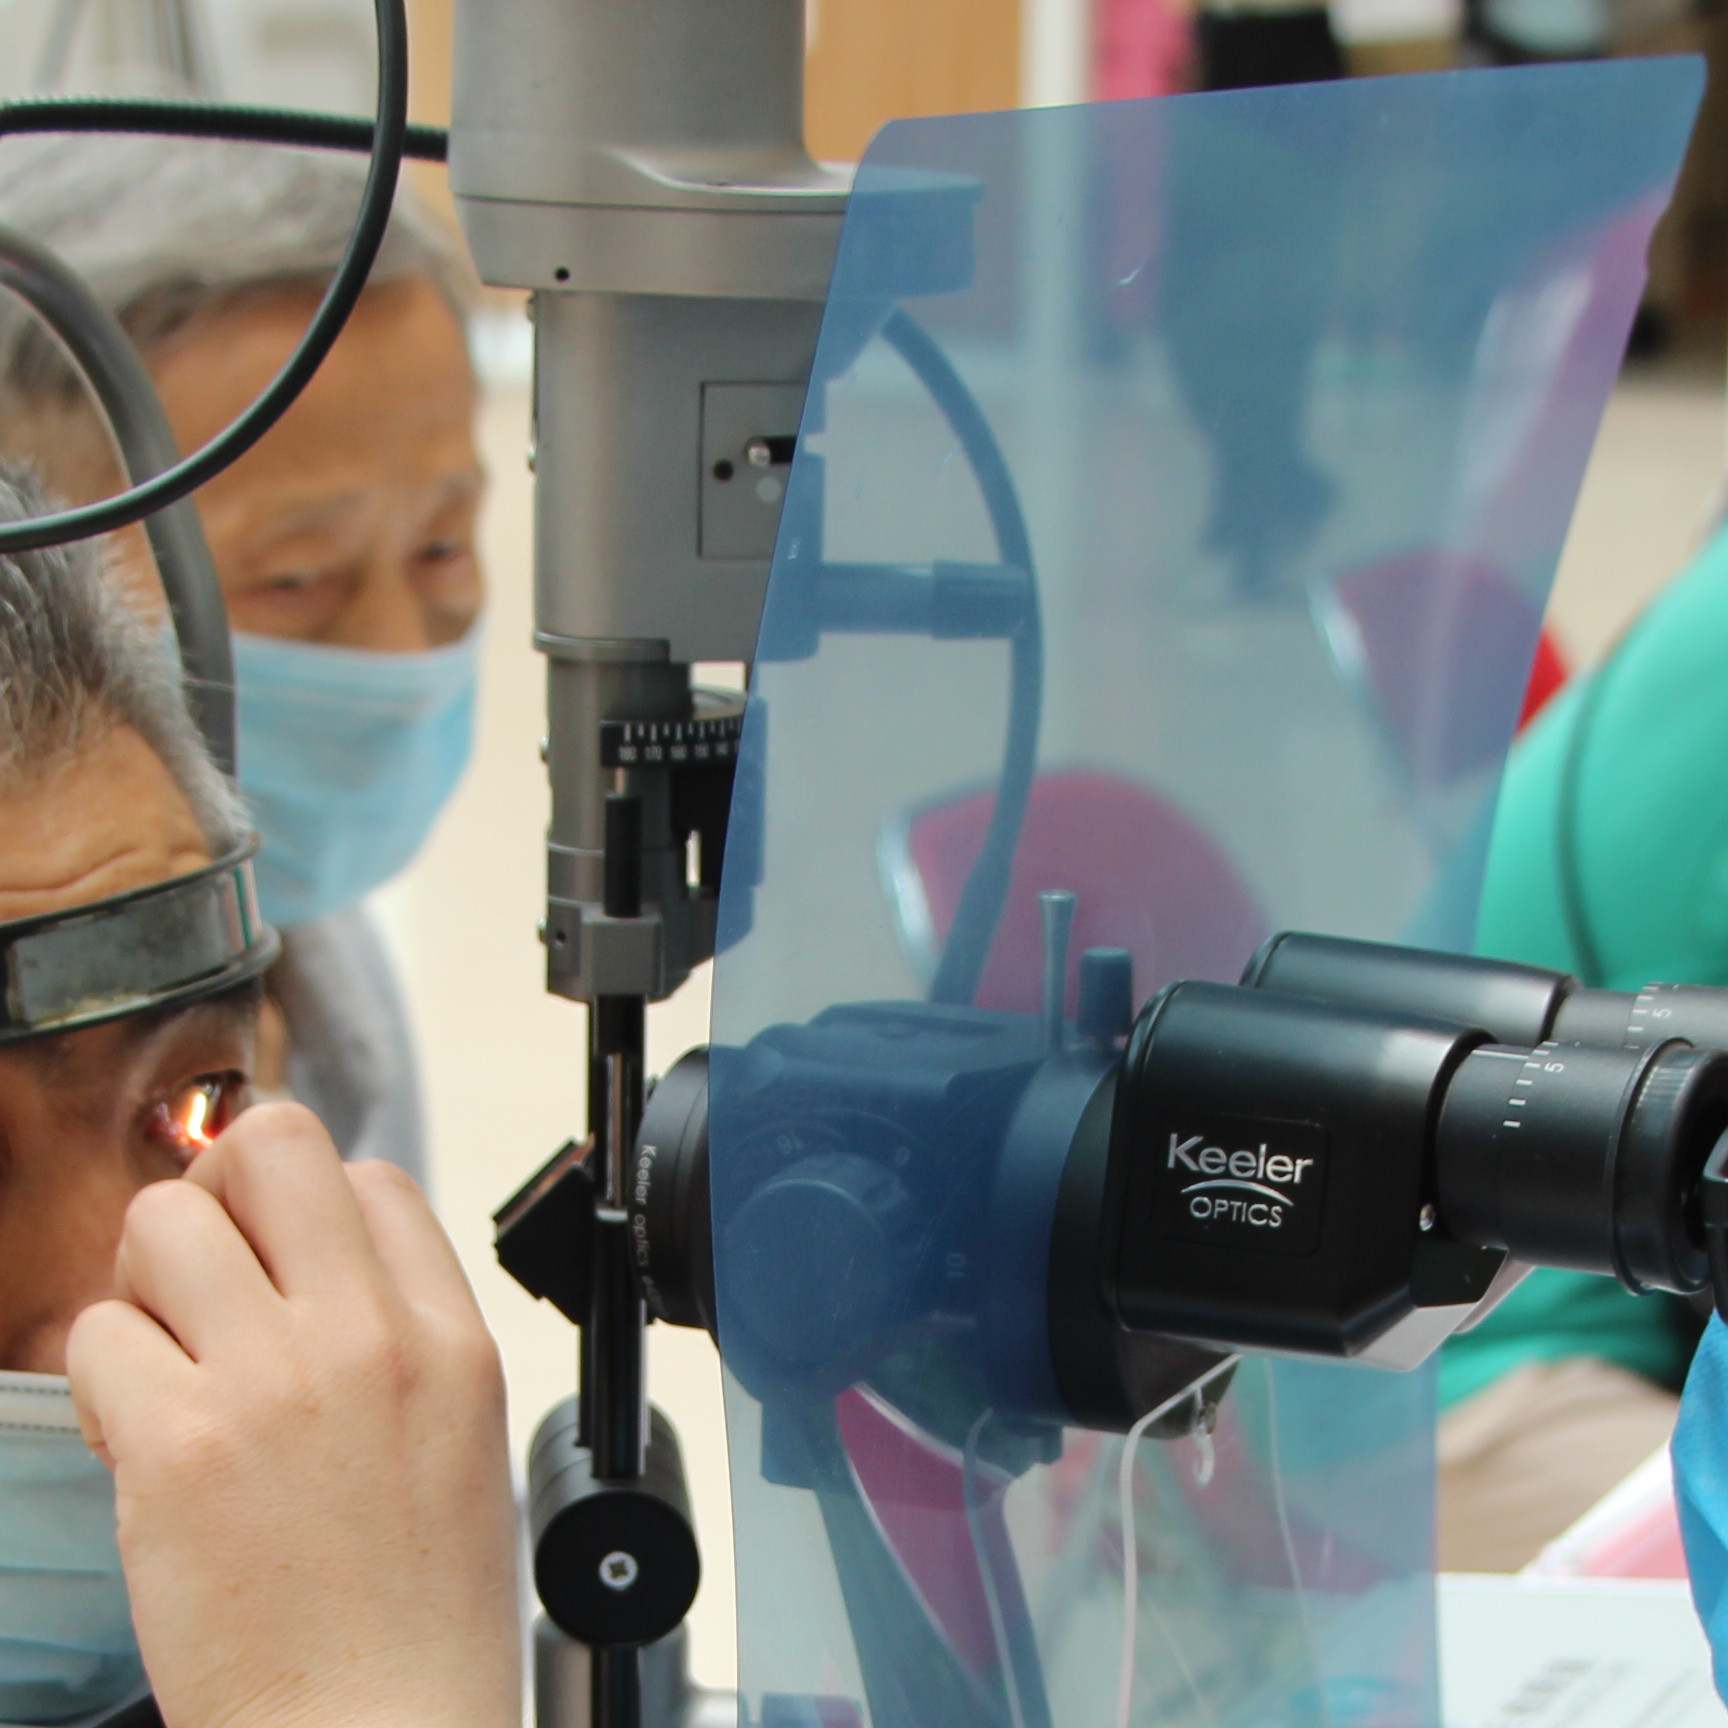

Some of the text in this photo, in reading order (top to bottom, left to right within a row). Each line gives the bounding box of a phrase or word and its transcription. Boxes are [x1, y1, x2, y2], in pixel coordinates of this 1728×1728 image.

[1544, 1062, 1564, 1073] 5
[635, 1144, 657, 1205] Keeler
[1167, 1133, 1314, 1184] Keeler
[1190, 1196, 1283, 1228] OPTICS
